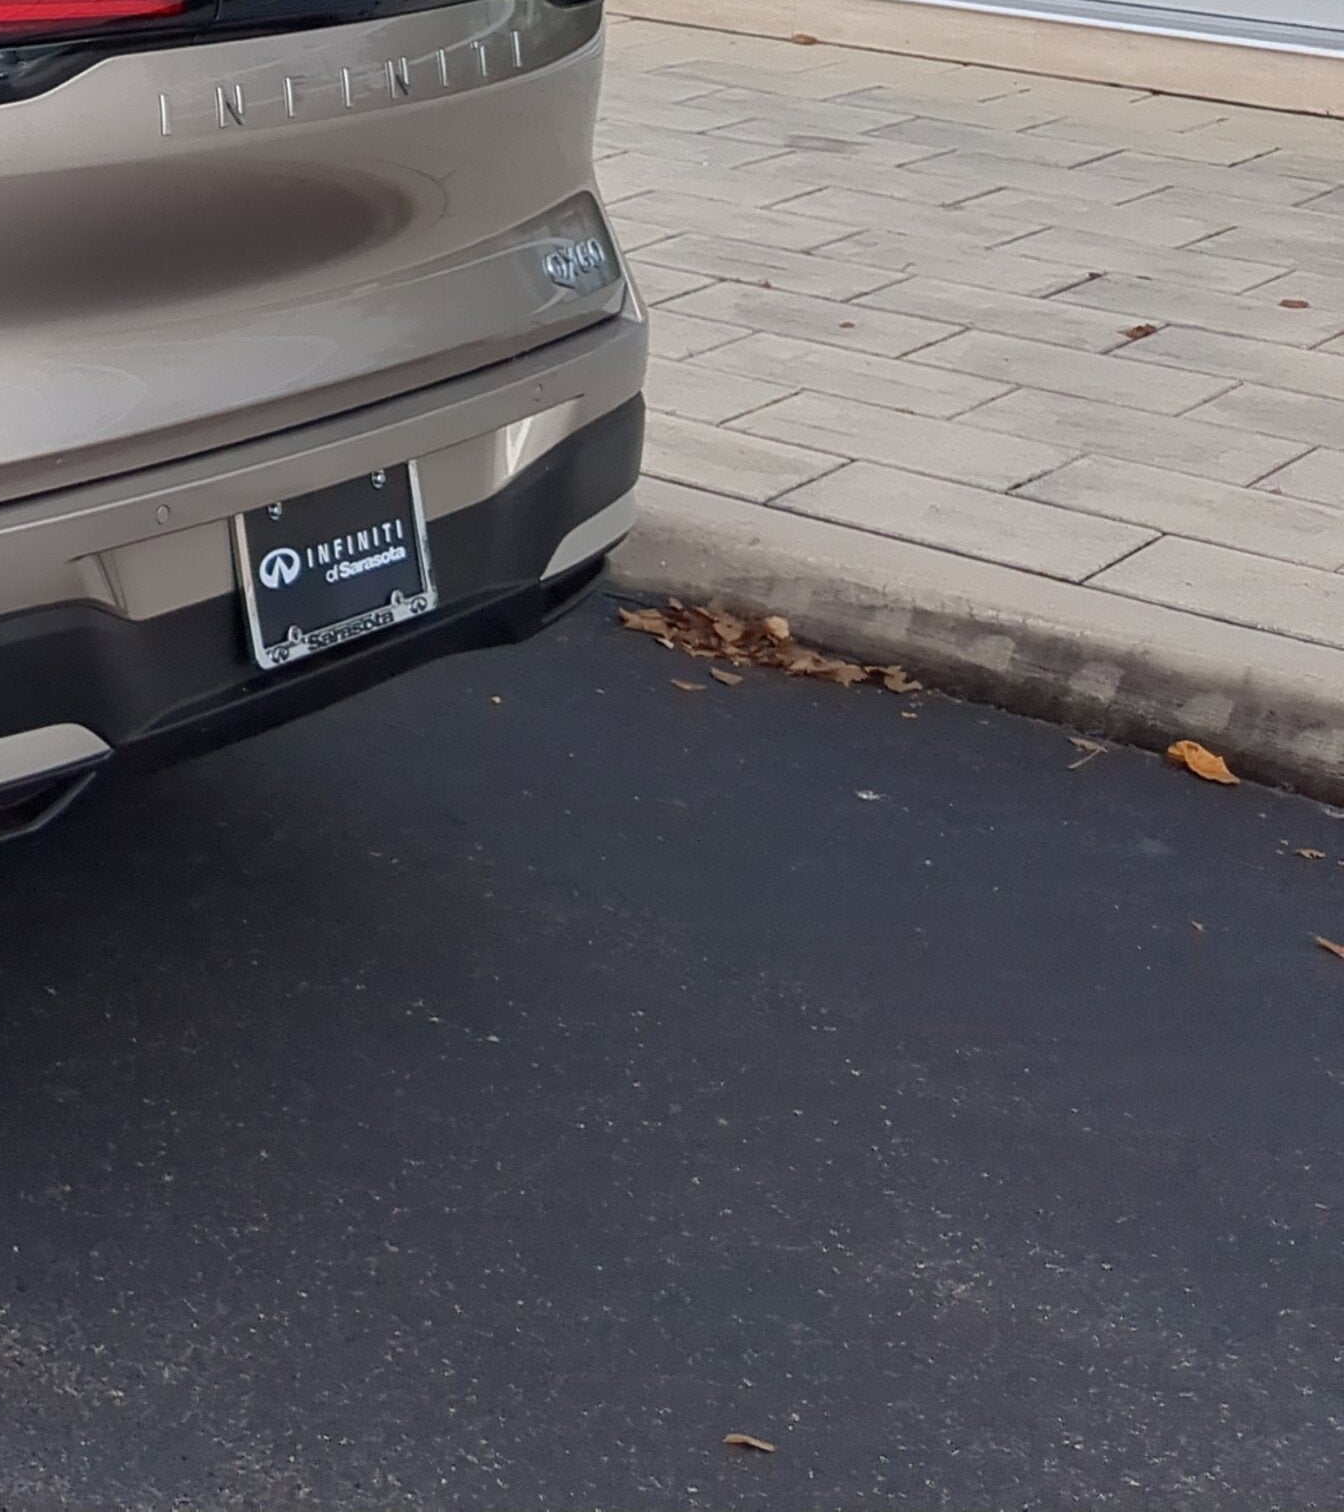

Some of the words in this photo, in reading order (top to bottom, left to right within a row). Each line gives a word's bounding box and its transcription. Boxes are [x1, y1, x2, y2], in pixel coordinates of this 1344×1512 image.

[159, 31, 522, 136] INFINITI
[307, 519, 403, 568] INFINITI
[339, 546, 407, 579] Sarasota
[308, 611, 394, 651] Sarasota
